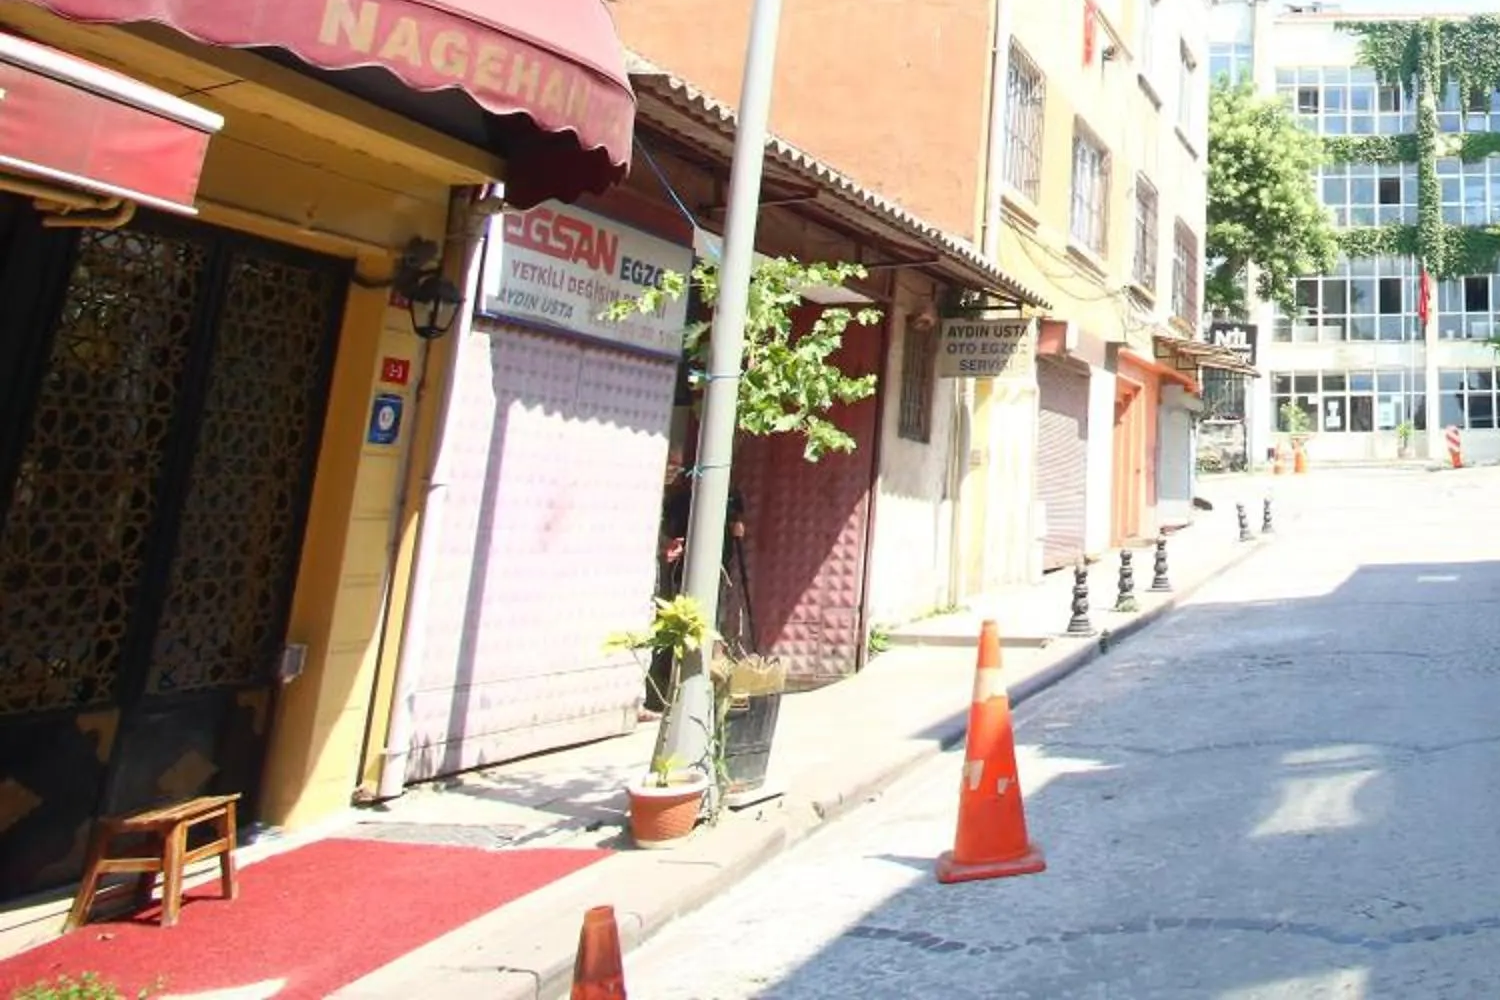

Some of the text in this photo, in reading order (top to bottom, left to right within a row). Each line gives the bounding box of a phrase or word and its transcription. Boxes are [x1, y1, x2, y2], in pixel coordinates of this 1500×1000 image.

[620, 256, 667, 292] EGZO
[540, 296, 574, 318] USTA
[947, 325, 1029, 338] AYDIN USTA
[946, 342, 977, 355] OTO
